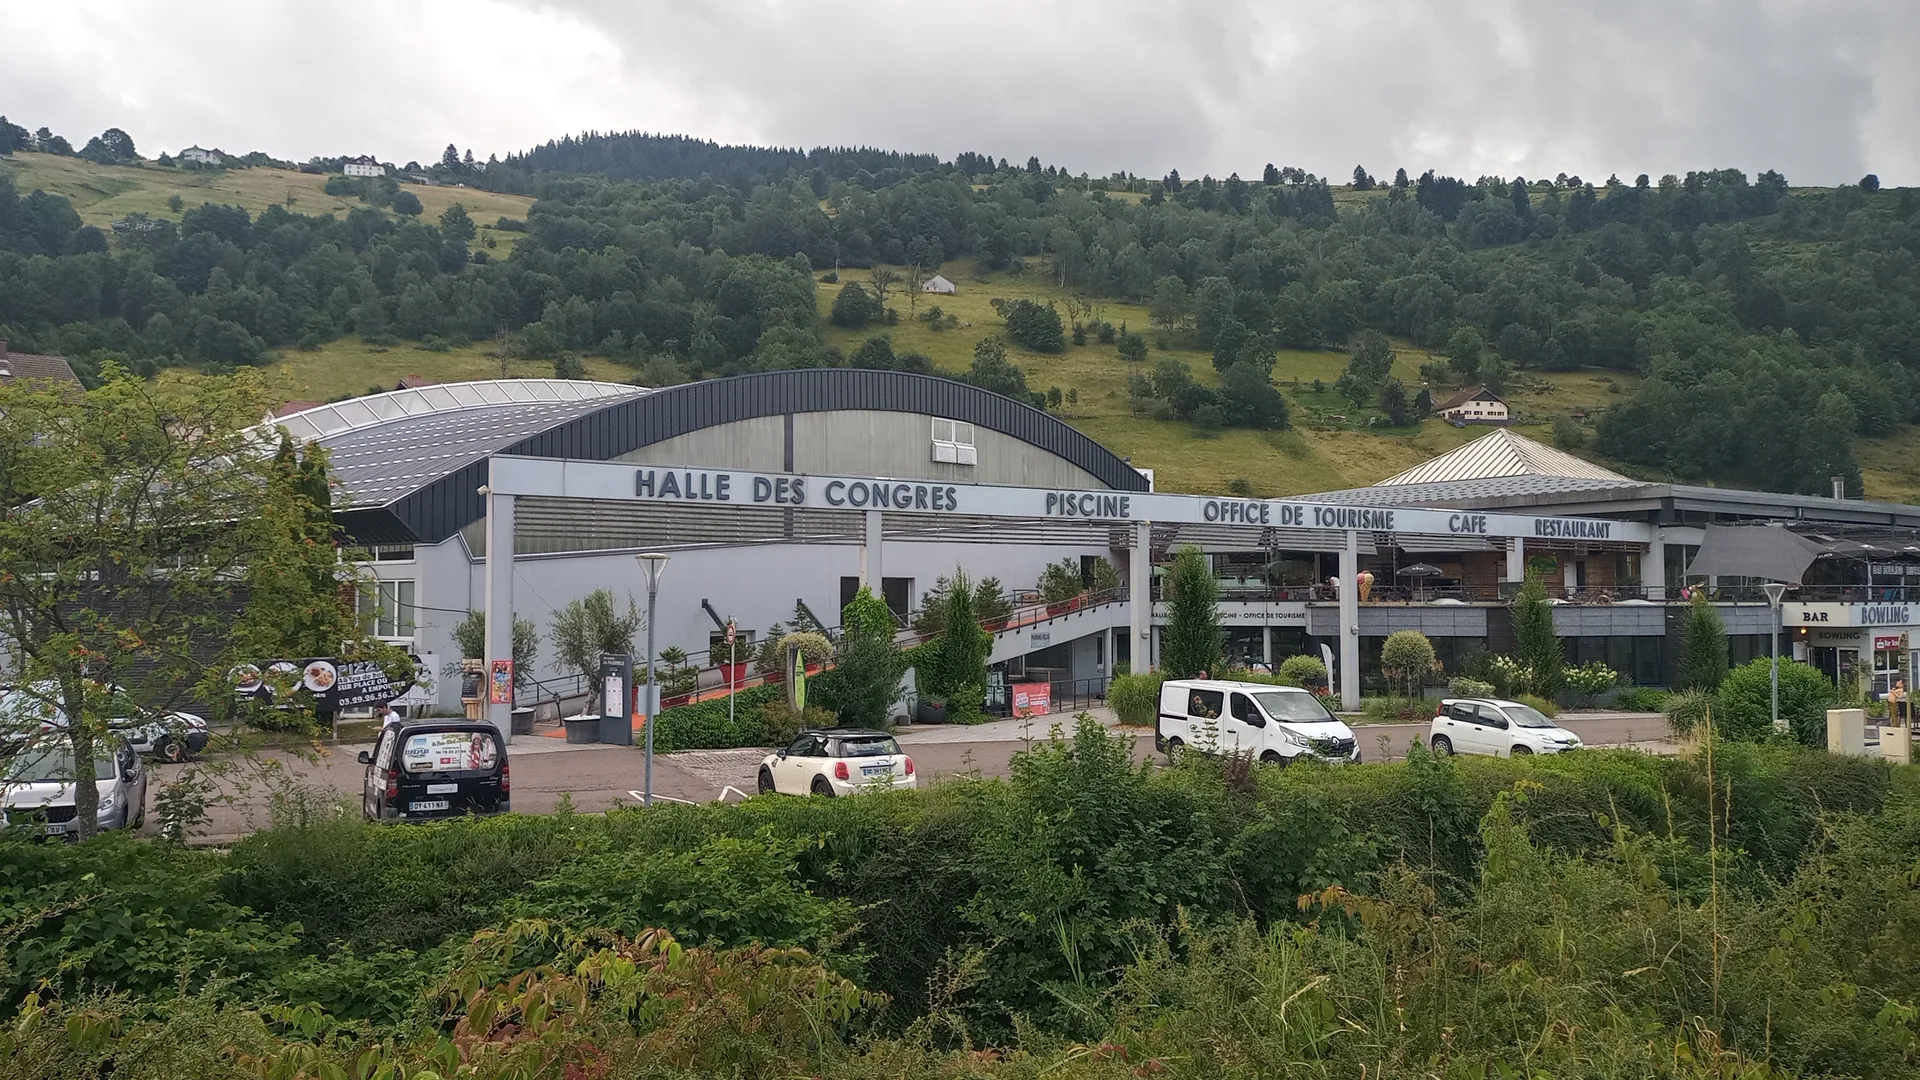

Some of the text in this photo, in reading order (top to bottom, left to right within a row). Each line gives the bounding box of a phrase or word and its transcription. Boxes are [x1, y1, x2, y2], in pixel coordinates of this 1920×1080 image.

[635, 469, 957, 511] HALLE DES CONGRES
[1046, 492, 1130, 518] PISCINE
[1203, 500, 1395, 530] OFFICE DE TOURISME
[1448, 513, 1487, 533] CAFE
[1534, 518, 1611, 539] RESTAURANT
[1802, 612, 1829, 622] BAR
[1861, 606, 1910, 625] BOWLING
[1818, 631, 1860, 640] BOWLING
[337, 661, 381, 677] PIZZ
[338, 677, 388, 692] SUR PLACE OU
